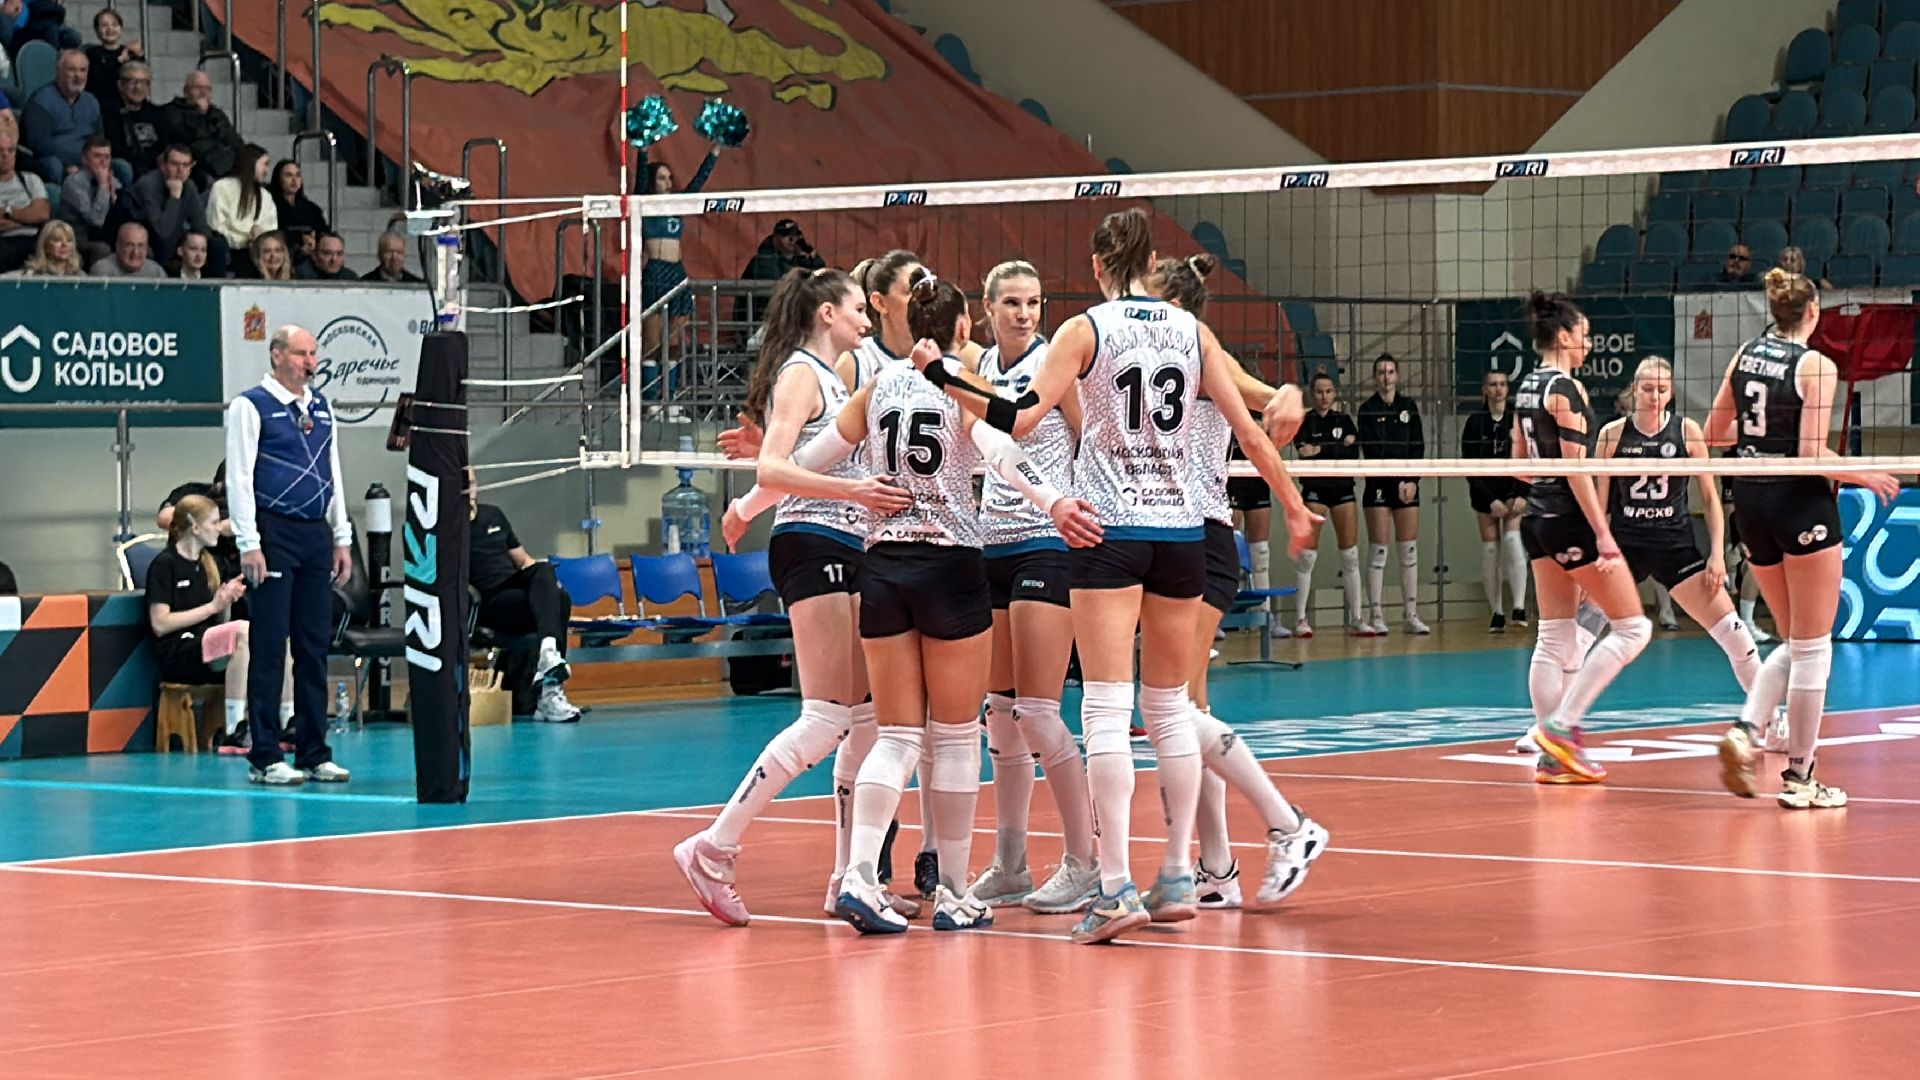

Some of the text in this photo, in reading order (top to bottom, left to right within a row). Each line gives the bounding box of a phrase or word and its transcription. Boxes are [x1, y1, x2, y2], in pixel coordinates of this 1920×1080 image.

[1500, 160, 1545, 177] PARI
[1733, 147, 1783, 164] PARI
[1078, 182, 1119, 197] PARI
[1284, 173, 1328, 188] PARI
[706, 199, 742, 213] PARI
[886, 191, 926, 206] PARI
[52, 331, 178, 360] САДОВОЕ
[54, 361, 164, 391] КОЛЬЦО
[316, 356, 400, 390] Заречье
[1115, 366, 1184, 432] 13
[1742, 380, 1768, 438] 3
[879, 410, 943, 476] 15
[1630, 474, 1669, 500] 23
[403, 464, 443, 673] PARI
